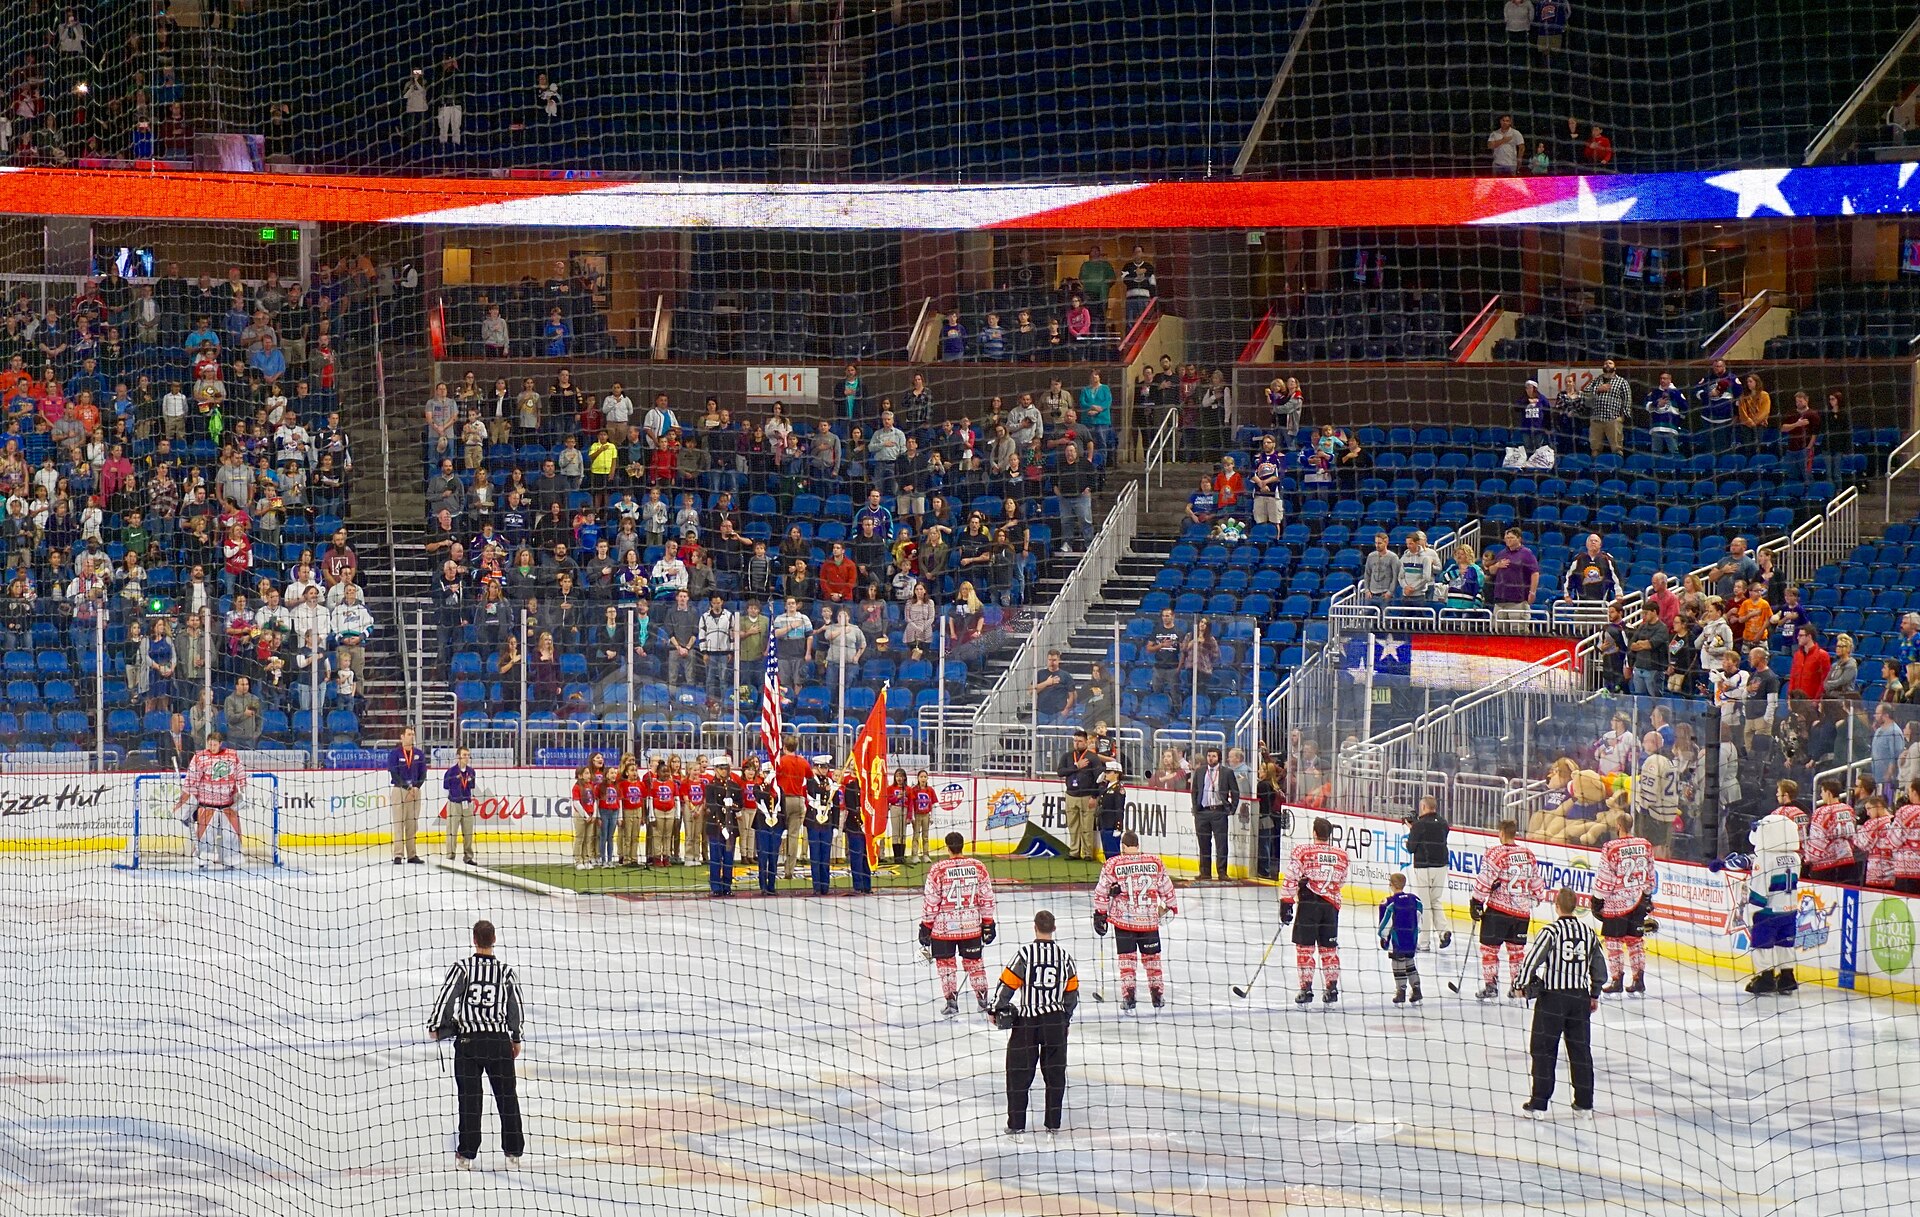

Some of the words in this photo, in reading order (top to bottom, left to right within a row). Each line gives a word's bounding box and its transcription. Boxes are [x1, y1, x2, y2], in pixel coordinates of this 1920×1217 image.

[763, 373, 802, 392] 111
[1371, 687, 1389, 702] EXIT
[0, 790, 51, 816] izza
[55, 784, 112, 811] Hut
[329, 791, 387, 813] prism
[531, 797, 573, 819] LIG
[57, 820, 134, 831] www.pizzahut.co
[1318, 853, 1337, 864] BAIER
[1620, 845, 1646, 857] BRADLEY
[947, 867, 977, 878] WATLING
[1319, 865, 1334, 895] 7
[1351, 863, 1392, 881] WrapThisInk.co
[1507, 863, 1534, 895] 27
[1621, 856, 1649, 889] 23
[946, 879, 980, 911] 47
[1125, 875, 1153, 906] 12
[1682, 885, 1724, 904] CHAMPION
[1874, 916, 1910, 938] WHOLE
[1561, 939, 1587, 961] 64
[1876, 933, 1911, 954] FOODS
[1033, 966, 1058, 988] 16
[467, 983, 497, 1008] 33
